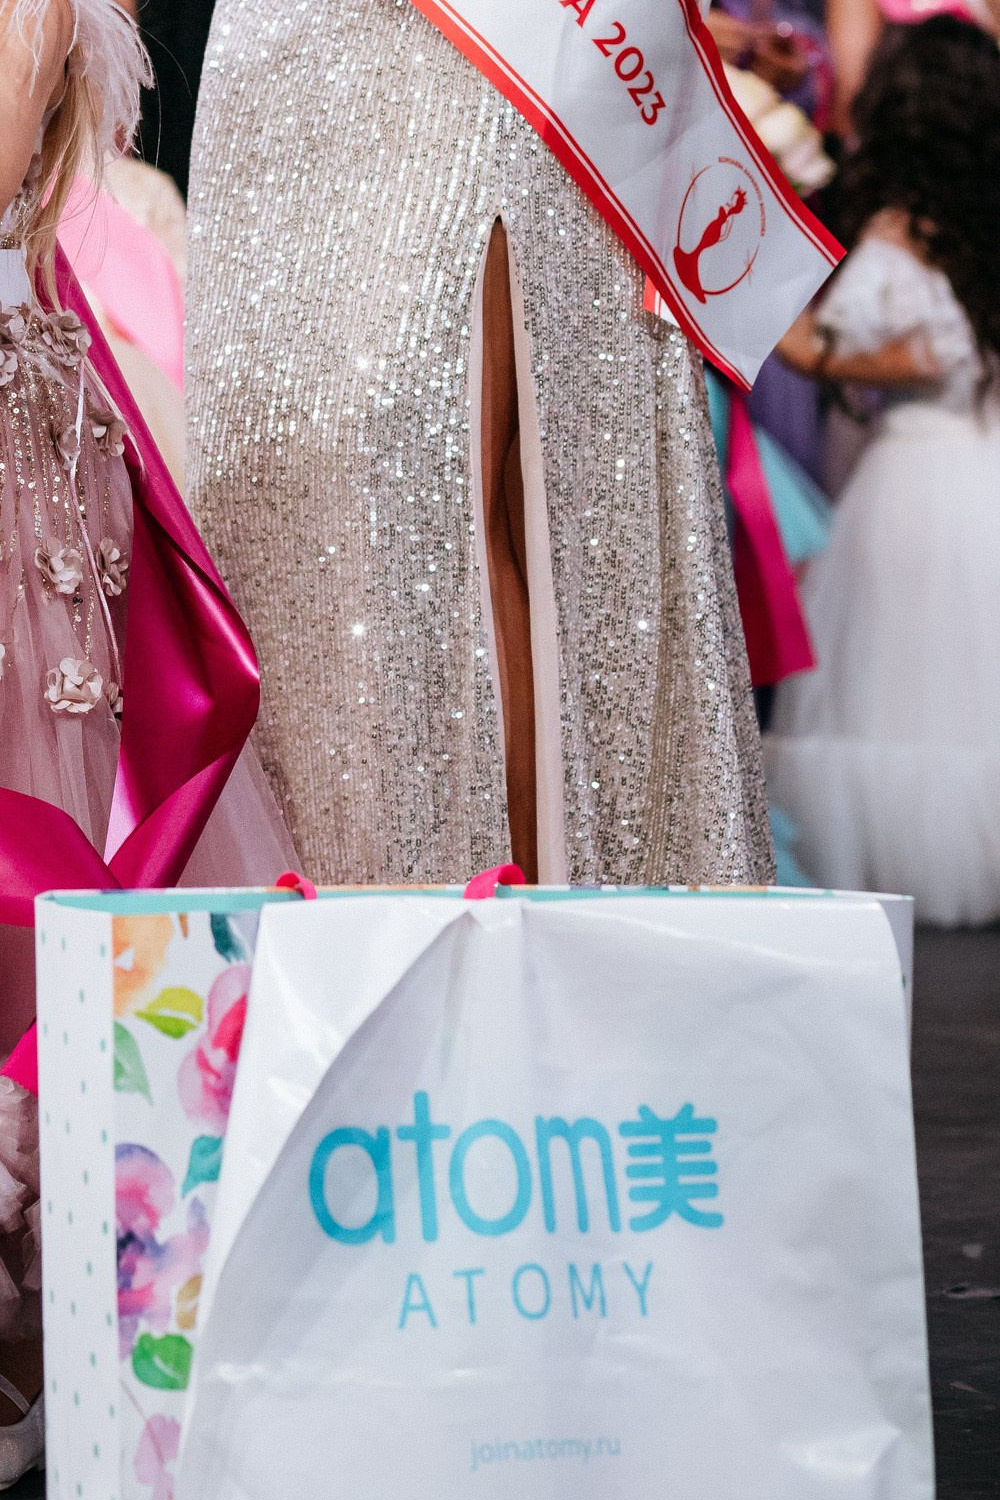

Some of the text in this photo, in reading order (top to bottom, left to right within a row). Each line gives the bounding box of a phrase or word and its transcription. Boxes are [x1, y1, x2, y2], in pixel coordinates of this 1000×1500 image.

[592, 21, 666, 126] 2023
[397, 1260, 655, 1330] ATOMY
[469, 1436, 622, 1472] joinatomy.ru
